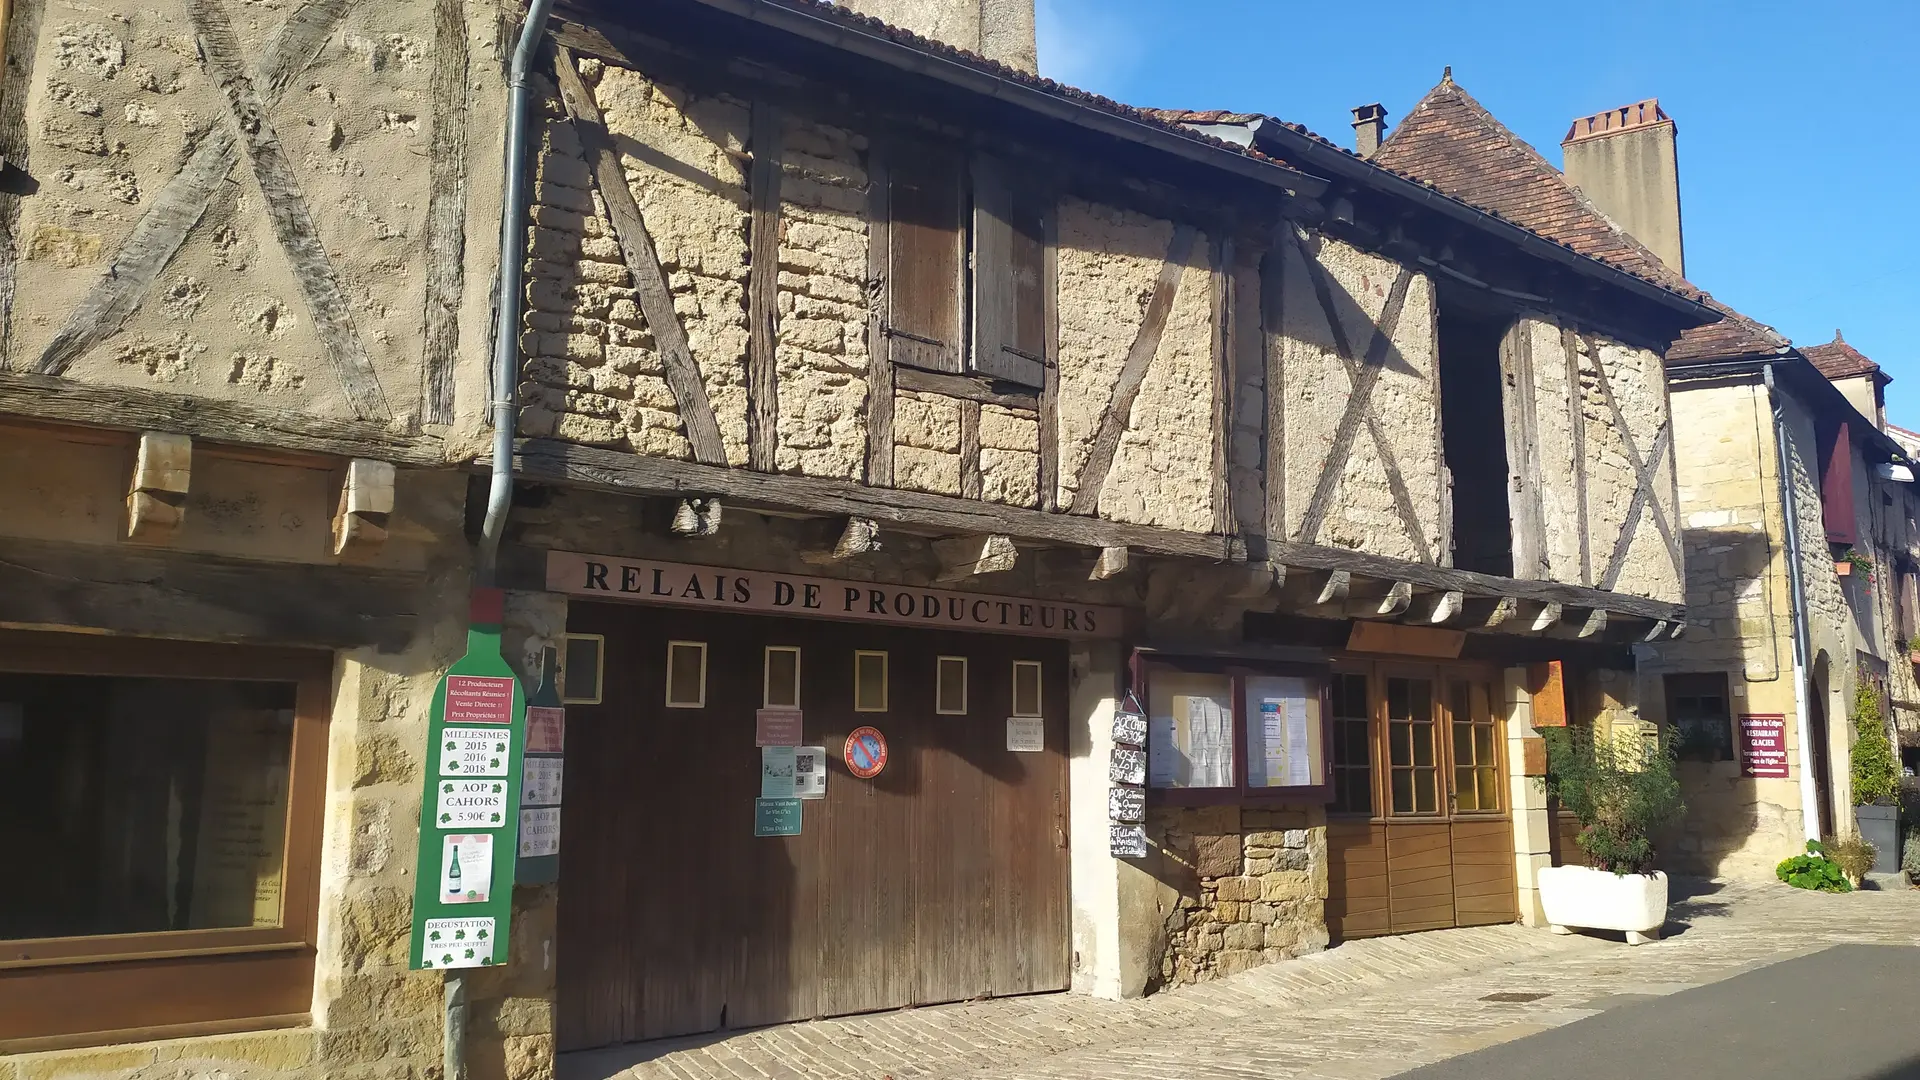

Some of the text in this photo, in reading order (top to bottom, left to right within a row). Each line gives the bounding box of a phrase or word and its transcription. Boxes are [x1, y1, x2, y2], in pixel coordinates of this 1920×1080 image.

[584, 561, 1098, 633] RELAIS DE PRODUCTEURS
[458, 680, 504, 688] 12 Producteurs
[450, 689, 480, 697] Récoltants
[455, 700, 473, 708] Vente
[474, 700, 497, 709] Directe
[451, 711, 464, 719] Prix
[1113, 716, 1130, 730] AOC
[1741, 719, 1762, 728] Spécialités
[1769, 720, 1783, 728] Crêpes
[444, 730, 509, 740] MILLESIMES
[1746, 729, 1779, 737] RESTAURANT
[464, 741, 487, 751] 2015
[463, 752, 486, 762] 2016
[1759, 749, 1785, 758] Panoramique
[463, 764, 486, 774] 2018
[461, 783, 488, 793] AOP
[446, 797, 499, 807] CAHORS
[457, 811, 485, 821] 5.90€
[535, 812, 550, 821] AOP
[526, 824, 557, 836] CAHORS
[427, 919, 493, 929] DEGUSTATION
